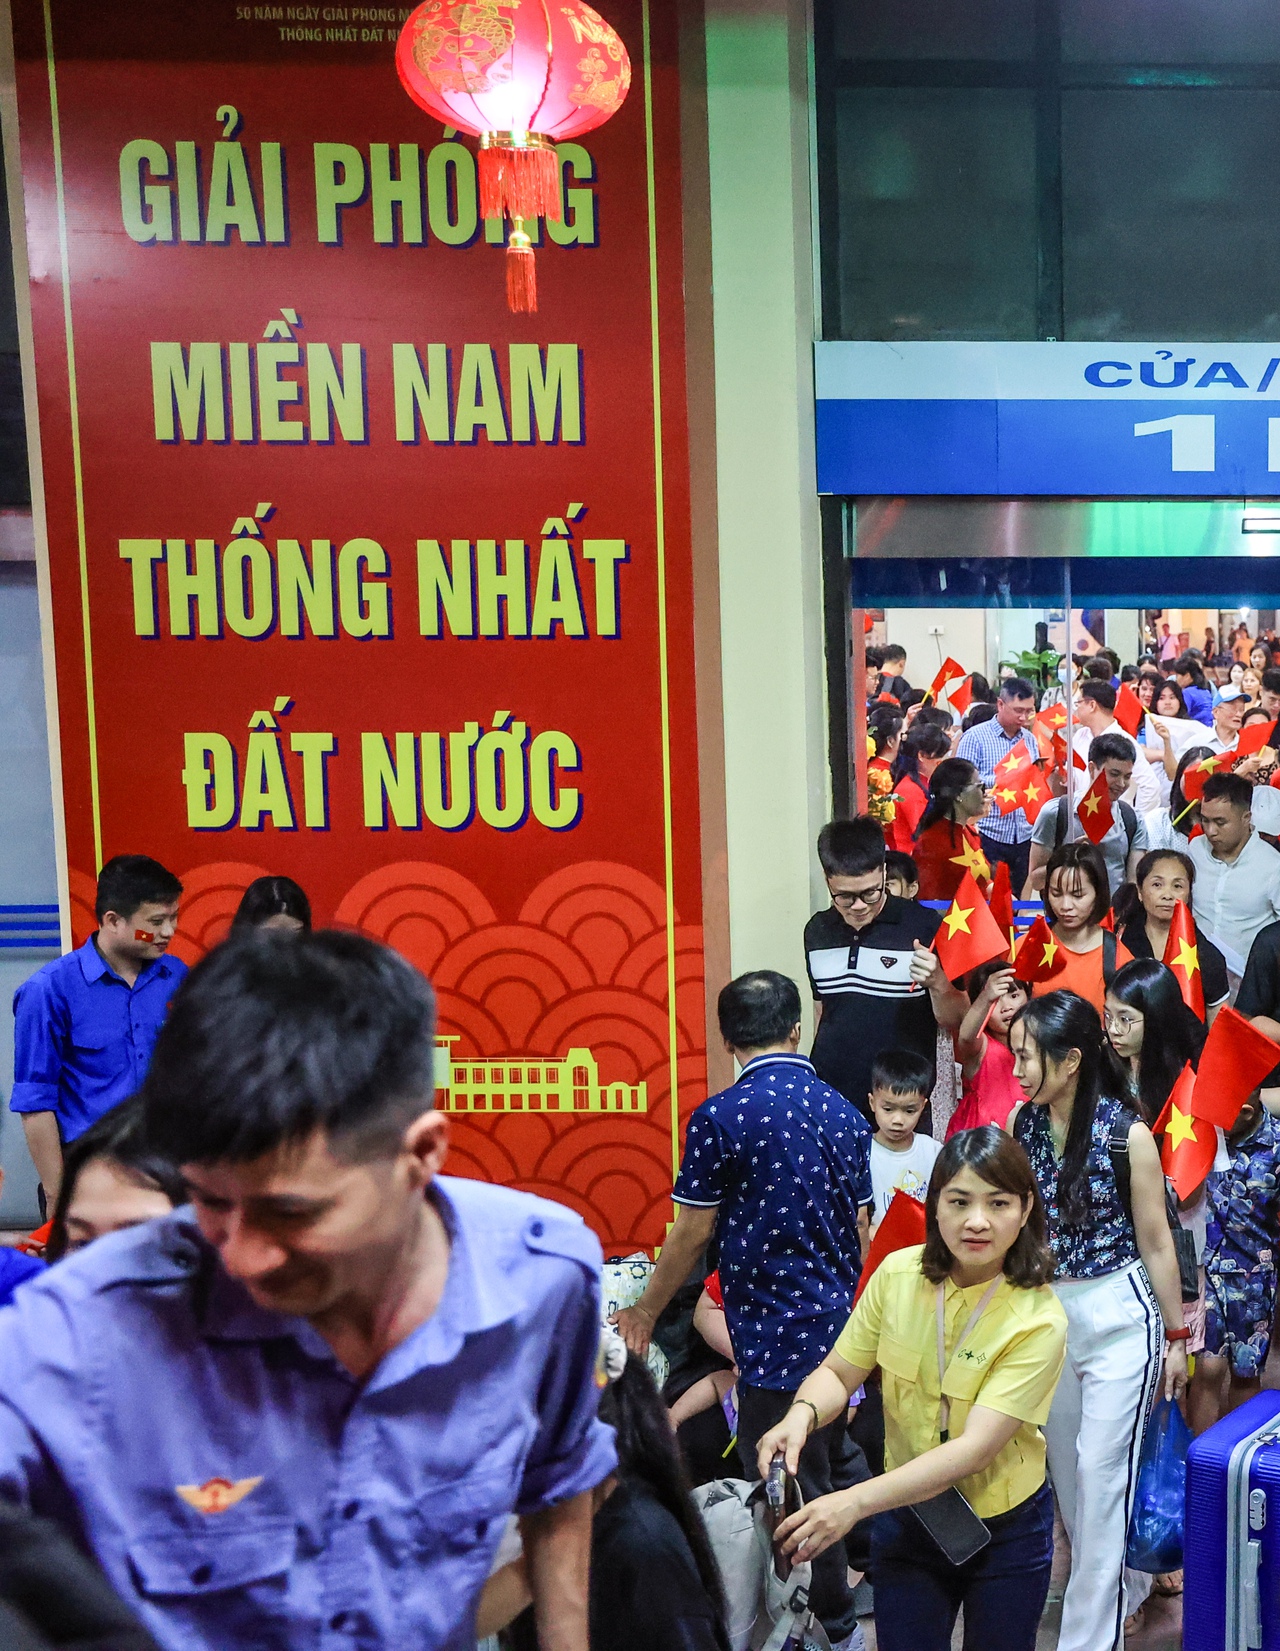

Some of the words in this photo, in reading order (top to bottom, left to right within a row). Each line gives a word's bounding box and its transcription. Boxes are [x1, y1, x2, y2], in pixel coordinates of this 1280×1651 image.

[236, 7, 250, 20] 50
[120, 105, 287, 244] GIẢI
[151, 308, 365, 442] MIỀN
[393, 343, 582, 443] NAM
[1133, 415, 1218, 473] 1
[119, 503, 390, 638] THỐNG
[417, 503, 627, 637] NHẤT
[182, 696, 335, 829] ĐẤT
[361, 711, 580, 830] NƯỚC
